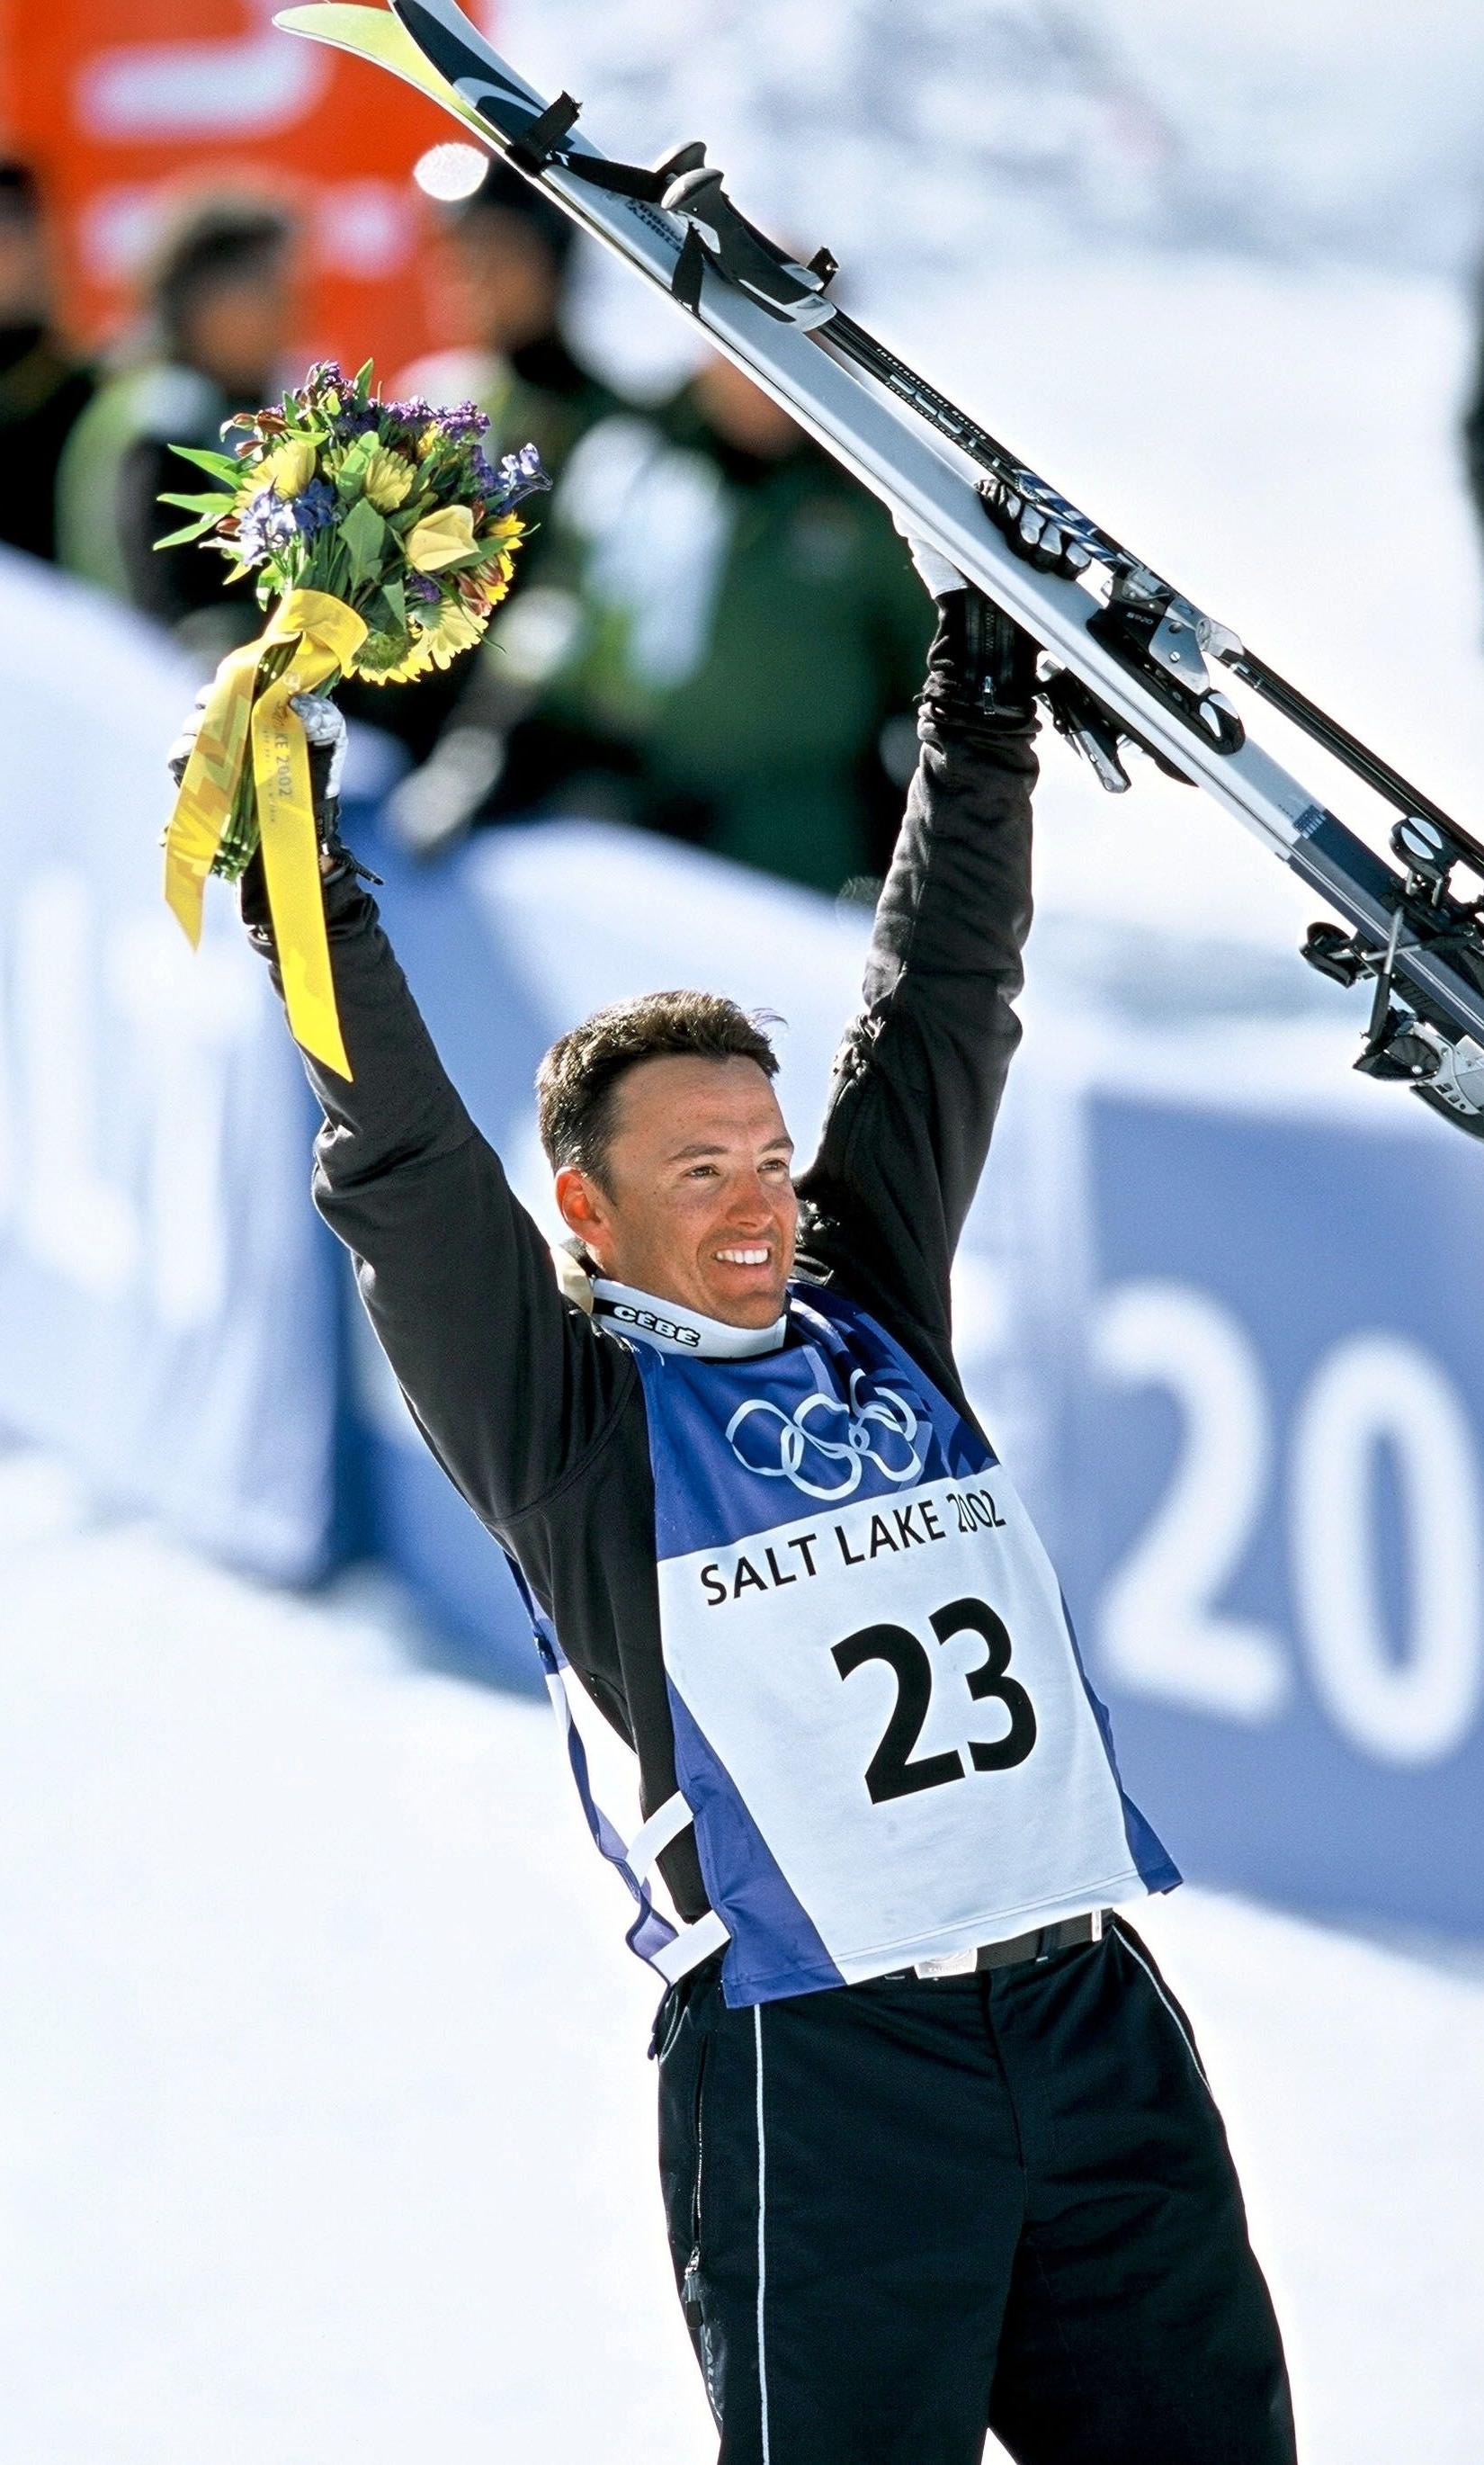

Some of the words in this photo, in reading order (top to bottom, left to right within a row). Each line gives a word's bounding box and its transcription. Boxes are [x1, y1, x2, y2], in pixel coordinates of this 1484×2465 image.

[875, 347, 950, 408] International
[951, 408, 988, 441] Racing
[277, 755, 292, 796] 2002
[701, 1533, 817, 1606] SALT
[834, 1500, 946, 1565] LAKE
[946, 1489, 1006, 1533] 2002
[830, 1597, 1037, 1805] 23
